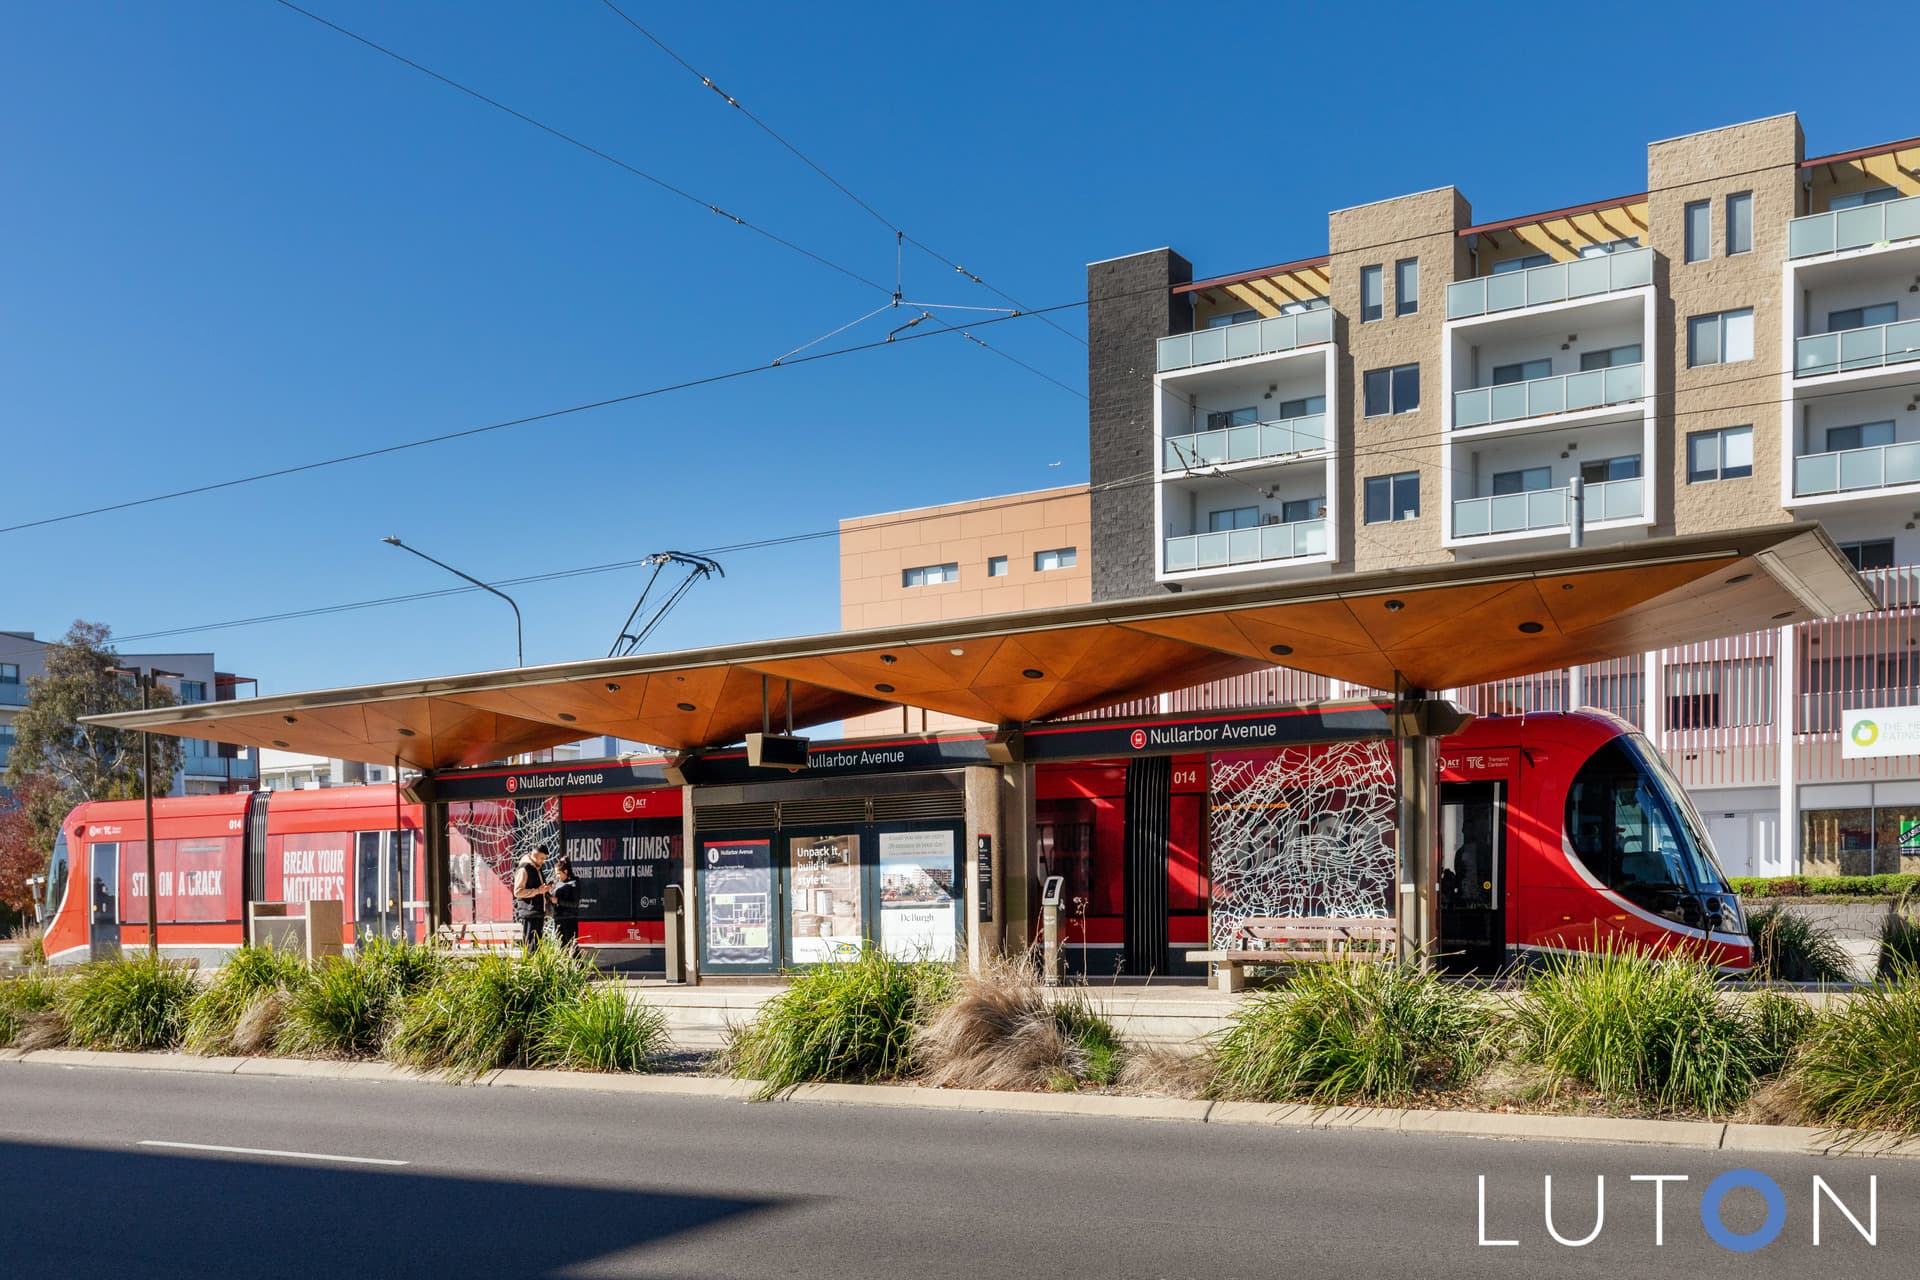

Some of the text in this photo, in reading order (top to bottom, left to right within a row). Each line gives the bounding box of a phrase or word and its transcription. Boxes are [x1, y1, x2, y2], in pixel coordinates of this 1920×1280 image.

[1151, 723, 1277, 744] Nullarbor Avenue
[860, 750, 905, 765] Avenue
[519, 773, 604, 789] Nullarbor Avenue
[1173, 771, 1196, 784] 014
[229, 819, 242, 830] 014
[566, 838, 601, 862] HEADS
[622, 836, 670, 860] THUMBS
[797, 847, 830, 860] Unpack
[283, 849, 344, 875] BREAK YOUR
[797, 860, 819, 873] build
[593, 866, 615, 878] TRACKS
[636, 865, 654, 877] GAME
[159, 872, 173, 896] ON
[178, 871, 186, 896] A
[188, 870, 222, 896] CRACK
[797, 875, 820, 888] style
[283, 876, 344, 905] MOTHER'S
